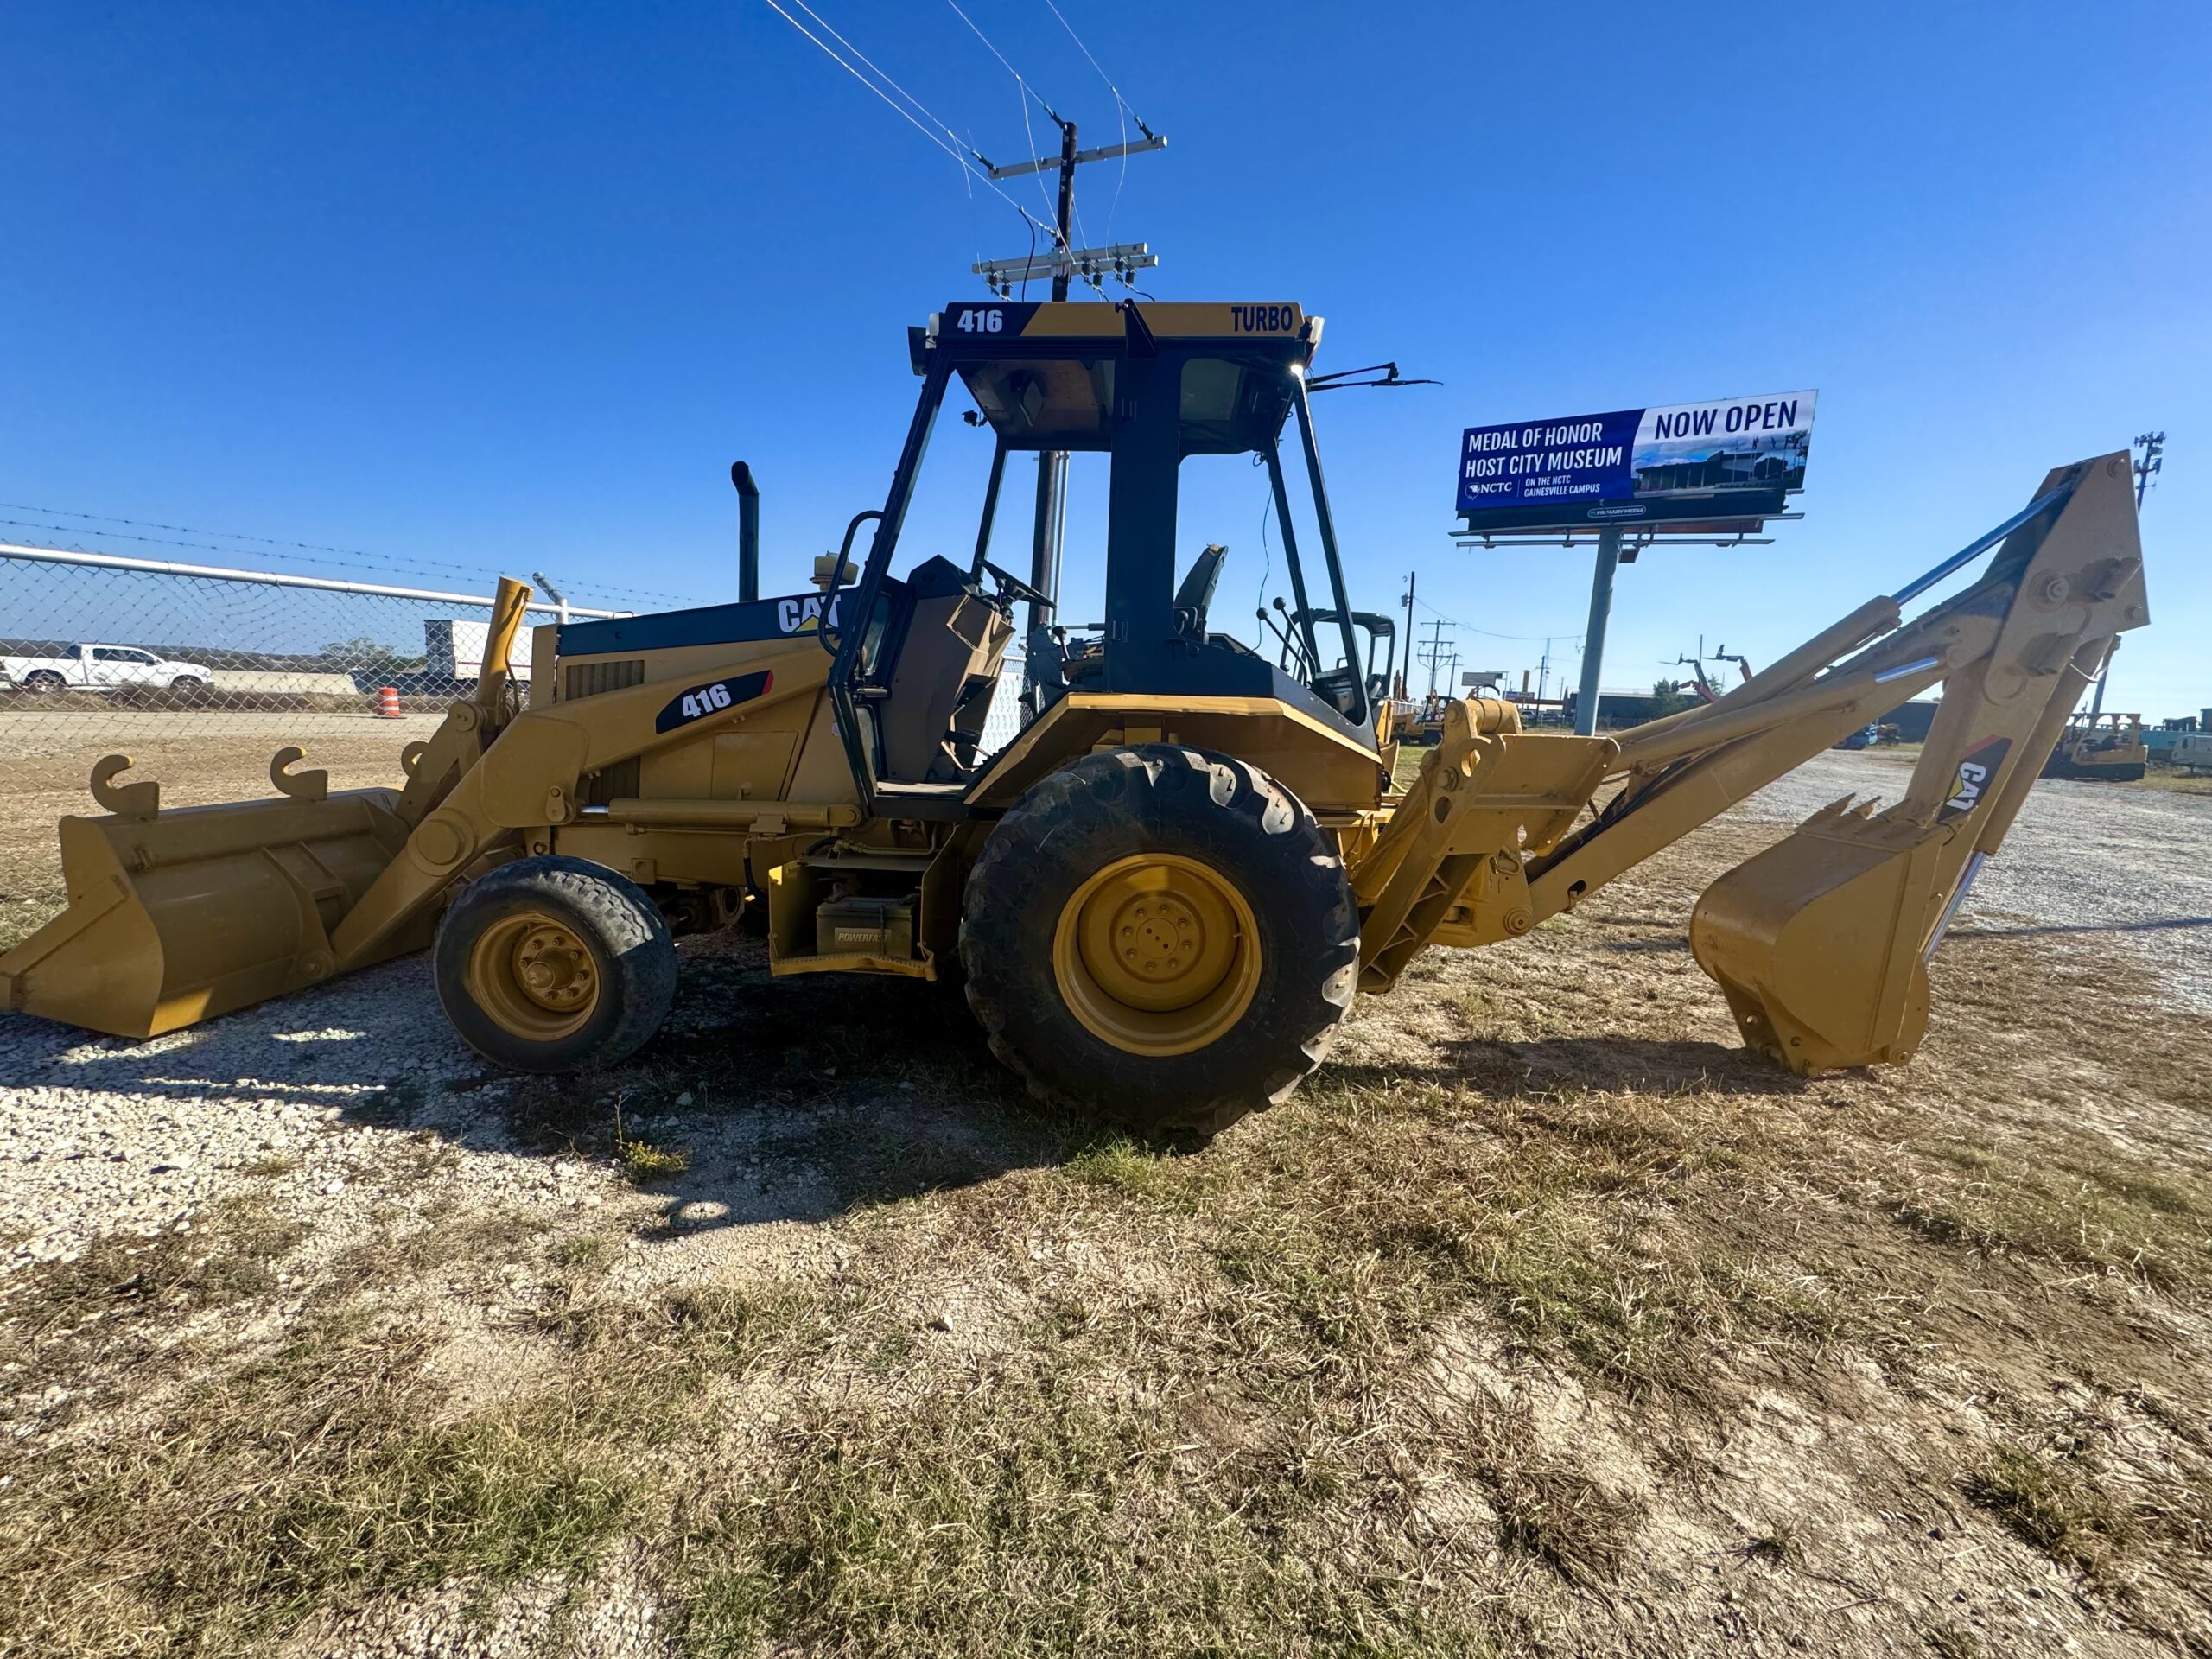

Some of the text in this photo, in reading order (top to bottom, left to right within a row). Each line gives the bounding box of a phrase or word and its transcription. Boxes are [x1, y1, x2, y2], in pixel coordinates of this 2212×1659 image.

[957, 309, 1003, 333] 416
[1230, 305, 1294, 333] TURBO
[1655, 399, 1798, 441] NOW OPEN
[1468, 422, 1603, 453] MEDAL OF HONOR
[1465, 446, 1623, 478] HOST CITY MUSEUM
[1480, 481, 1513, 493] NCTC
[1523, 483, 1601, 498] GAINESVILLE CAMPUS
[1525, 474, 1572, 487] ON THE NCTC
[778, 594, 842, 633] CAT
[683, 683, 732, 717] 416
[1945, 761, 1986, 810] CAT
